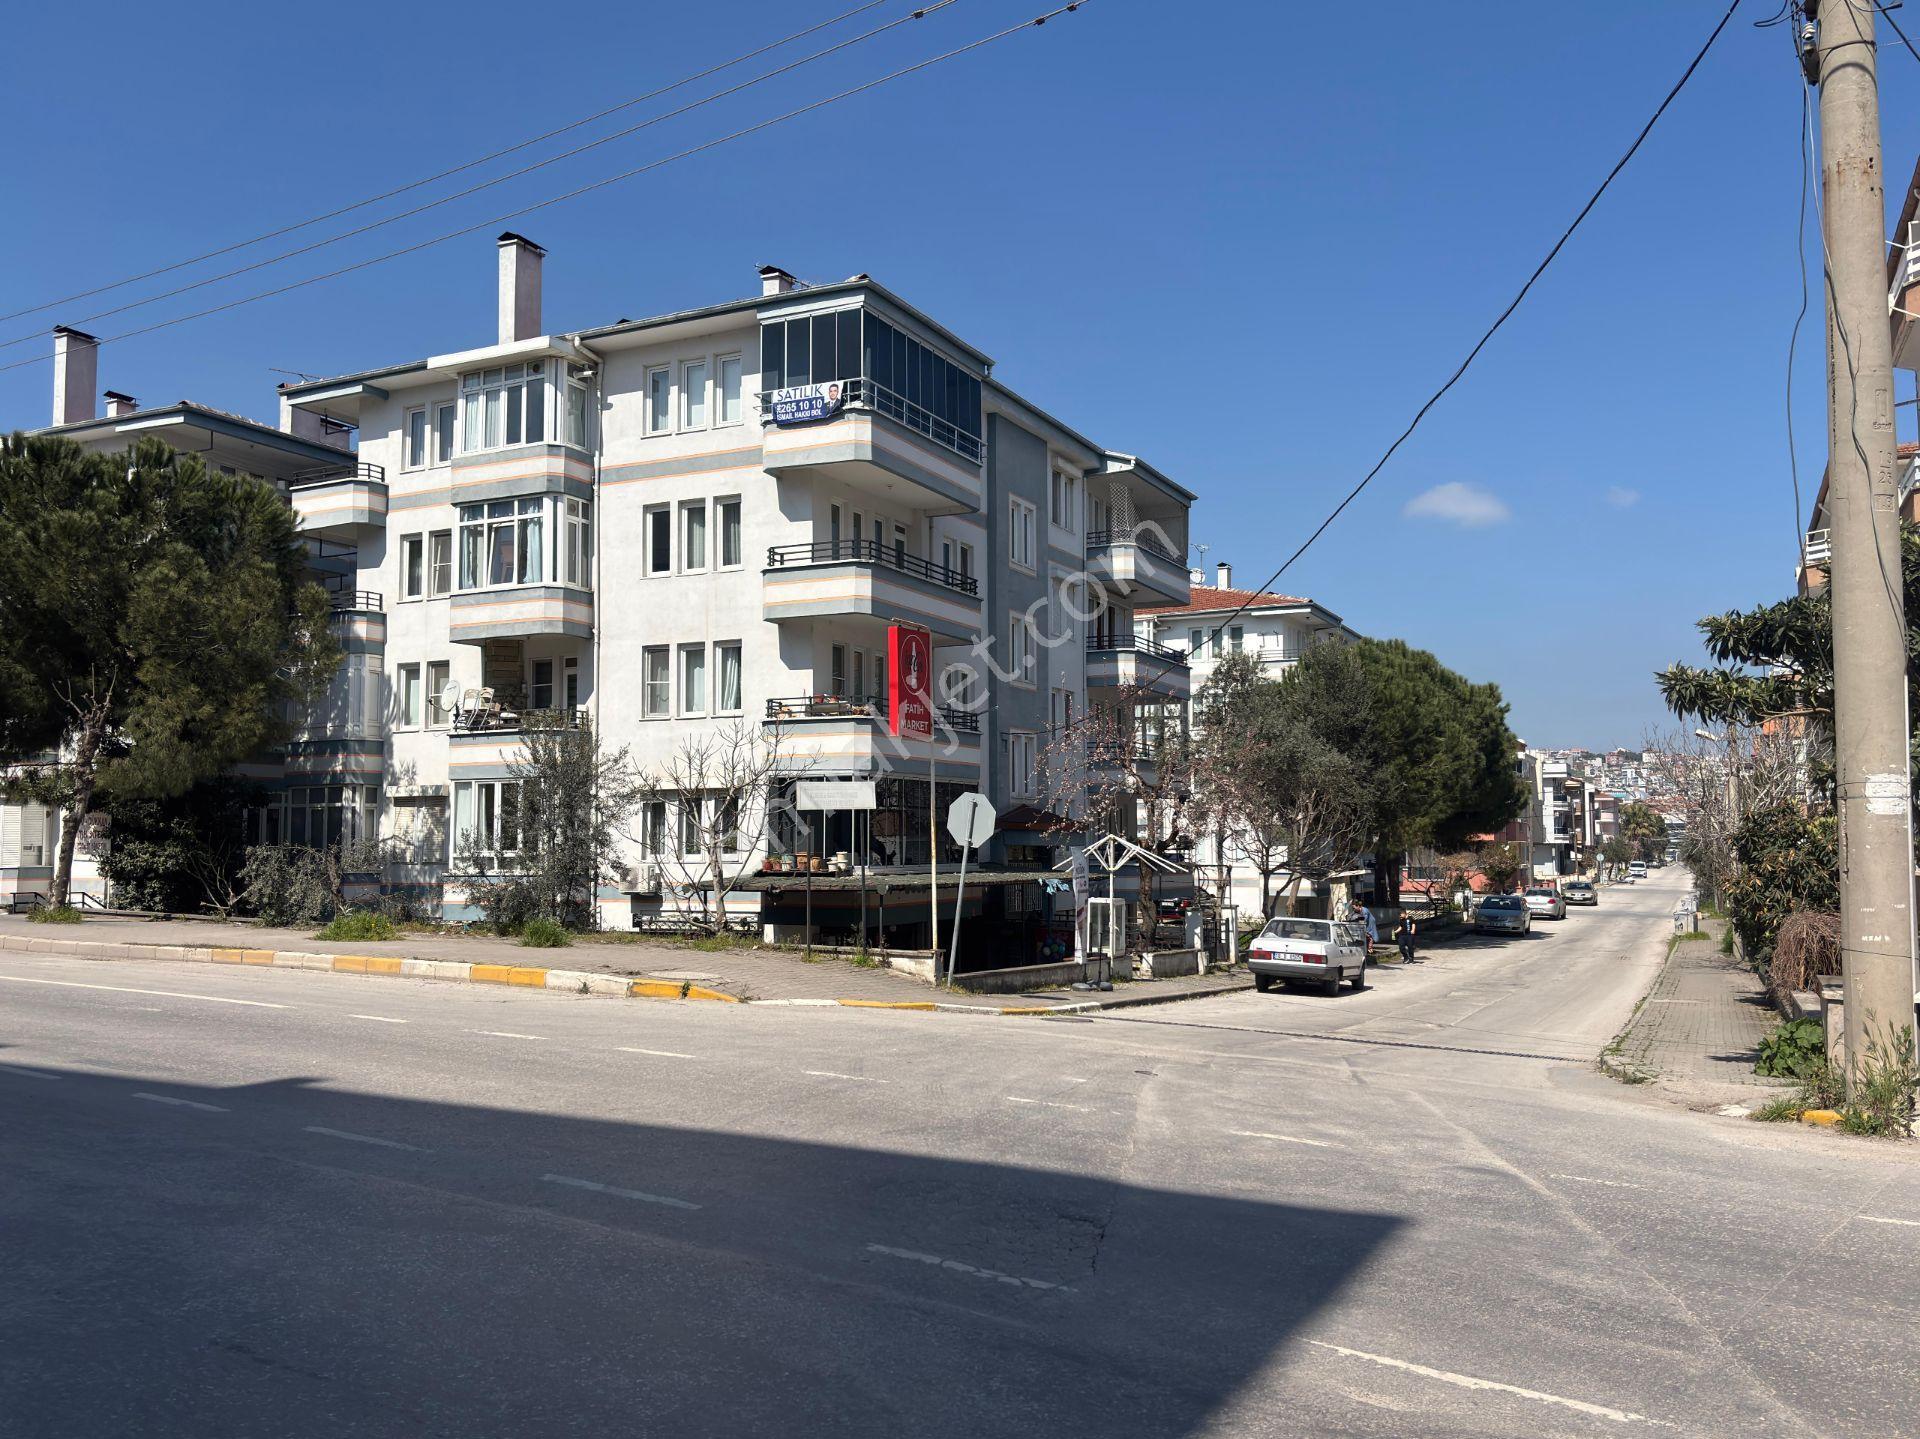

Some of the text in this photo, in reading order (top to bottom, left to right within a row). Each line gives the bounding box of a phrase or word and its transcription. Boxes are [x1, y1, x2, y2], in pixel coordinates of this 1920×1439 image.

[777, 384, 823, 402] SATILIK
[799, 400, 809, 411] 10
[812, 399, 822, 409] 10
[900, 719, 929, 731] MARKET
